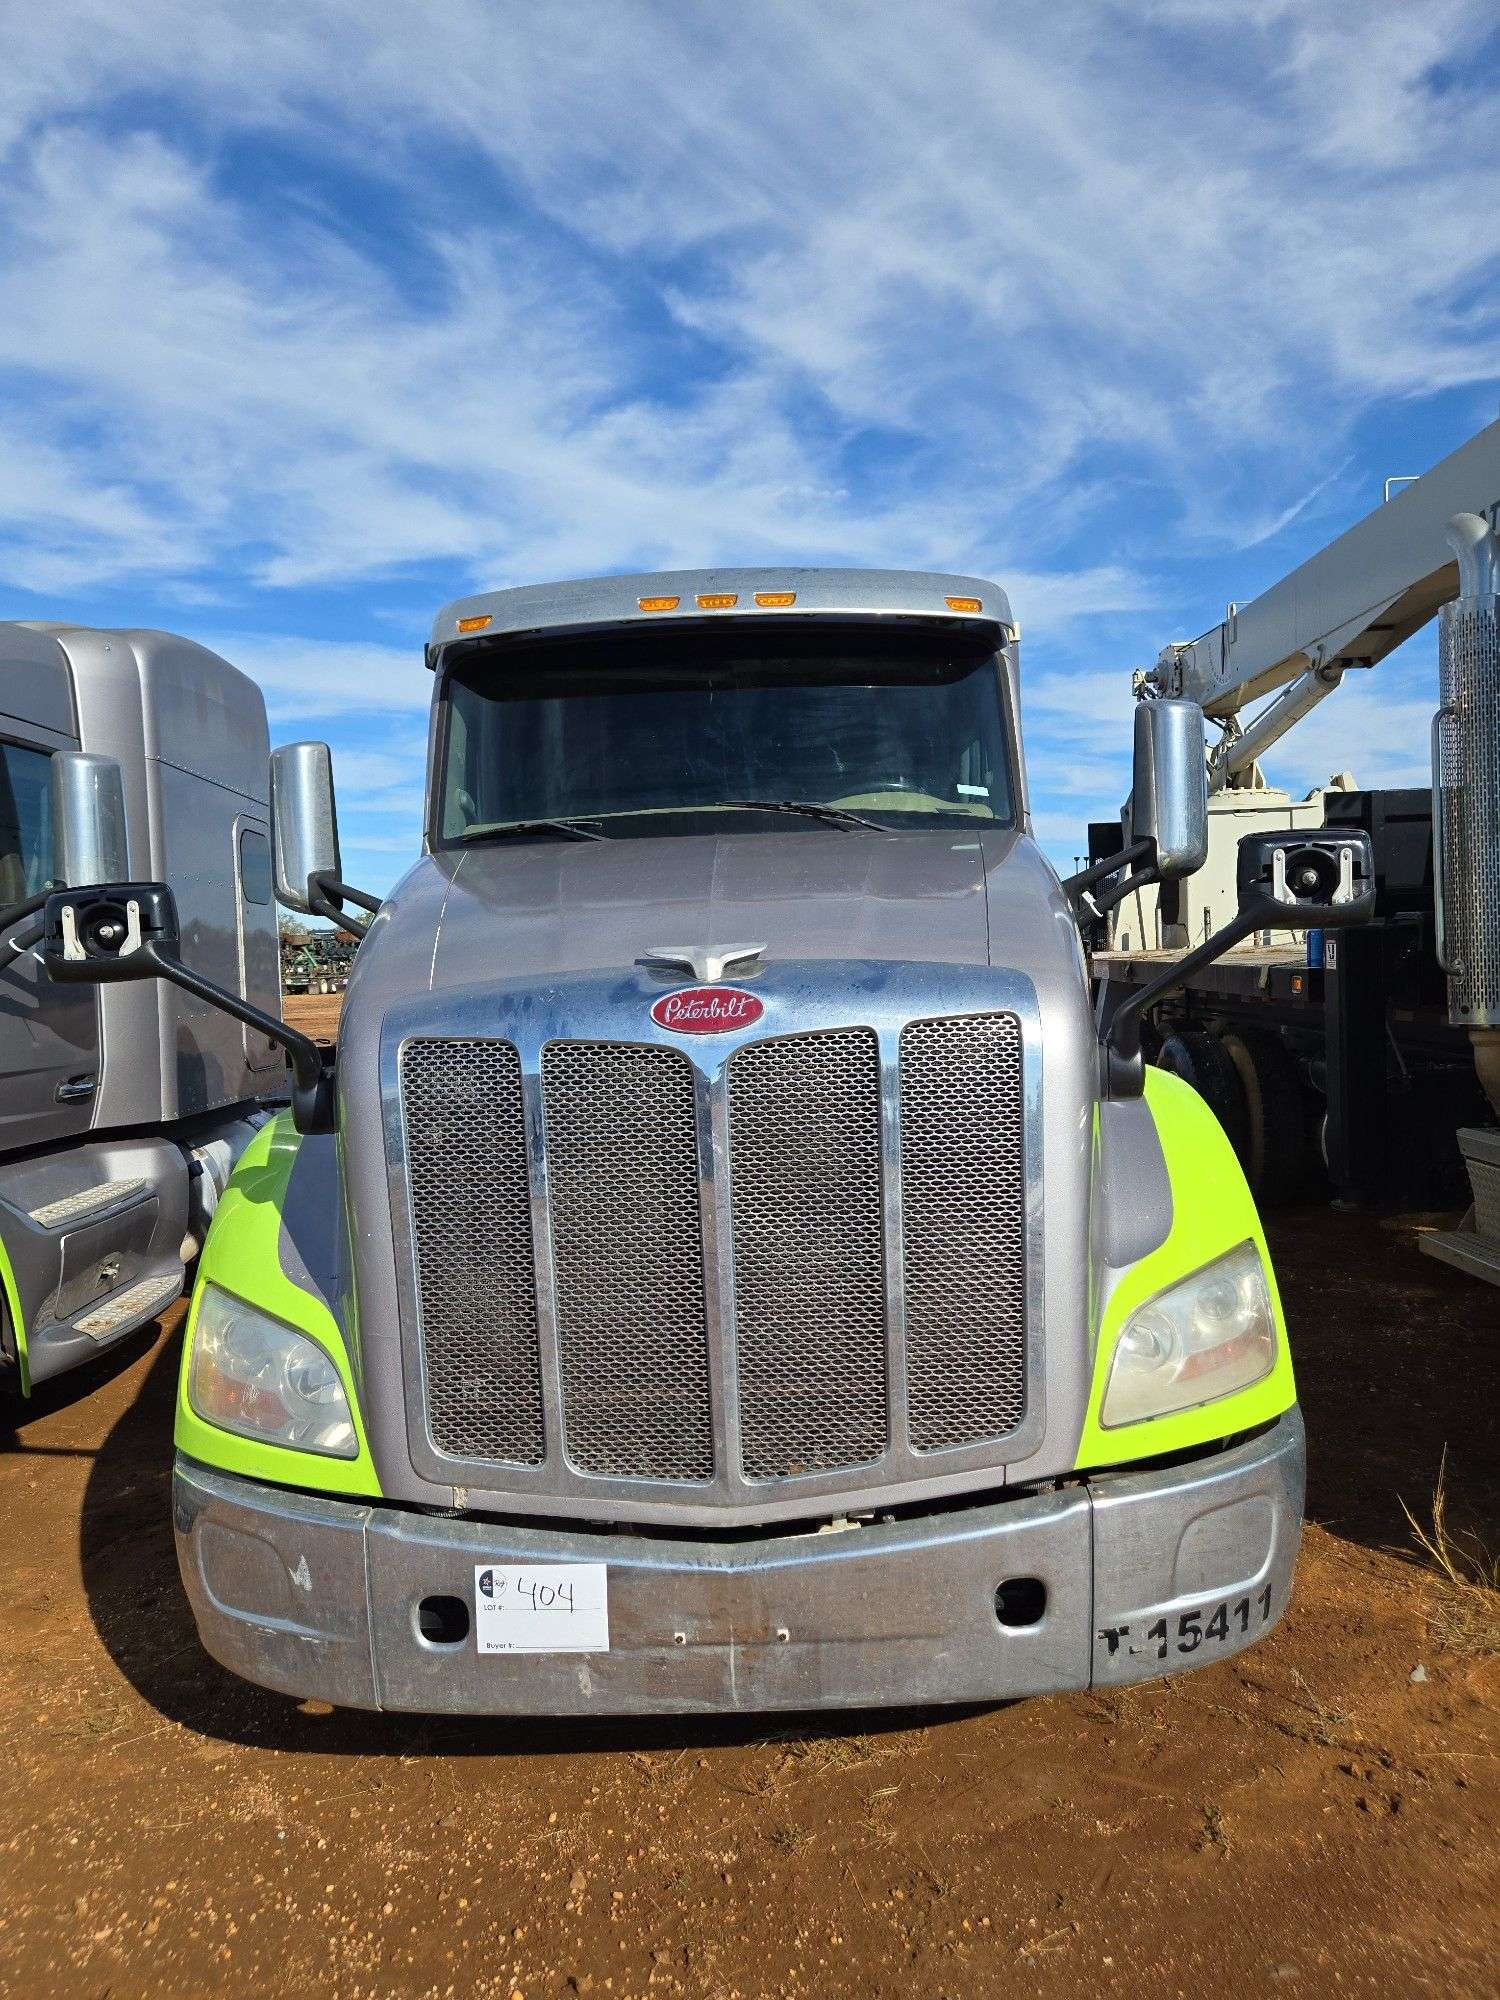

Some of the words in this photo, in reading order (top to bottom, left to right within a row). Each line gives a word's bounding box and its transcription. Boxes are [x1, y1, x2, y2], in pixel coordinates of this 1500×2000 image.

[664, 997, 754, 1023] Peterbilt
[517, 1577, 573, 1613] 404
[1098, 1583, 1272, 1659] T15411
[486, 1642, 507, 1650] Buyer
